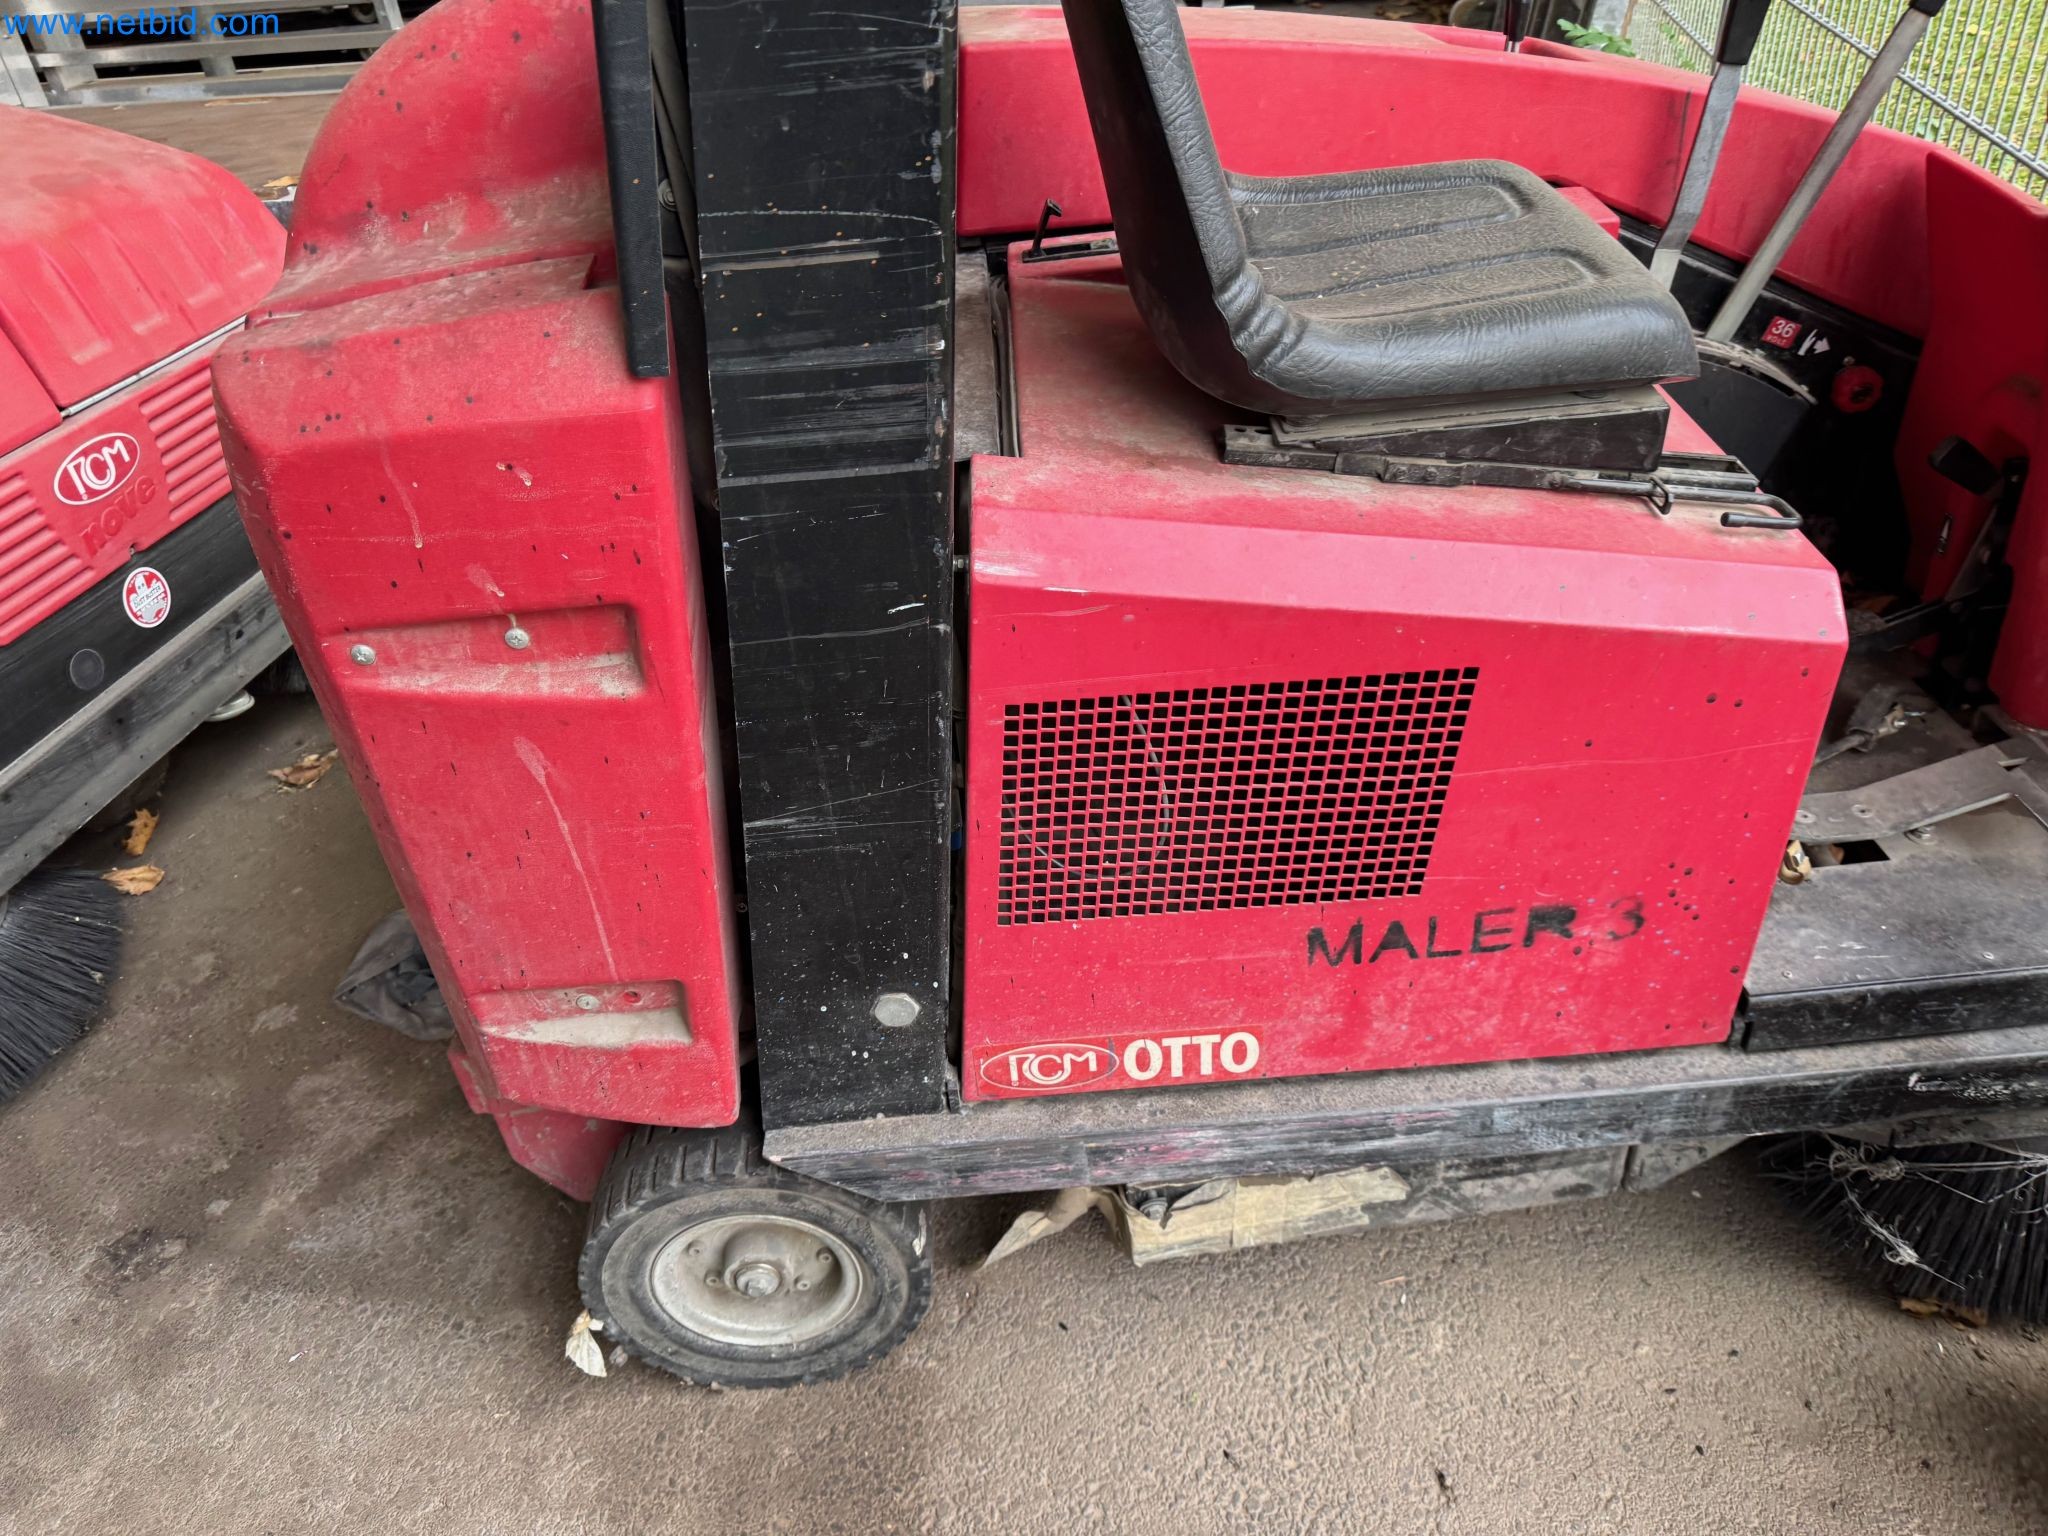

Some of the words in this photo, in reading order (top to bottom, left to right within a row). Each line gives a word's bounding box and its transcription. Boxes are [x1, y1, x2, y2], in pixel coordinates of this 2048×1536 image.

[1771, 319, 1796, 337] 36
[66, 439, 130, 500] RCM
[1305, 904, 1577, 968] MALER
[1609, 895, 1645, 941] 3
[1008, 1050, 1098, 1087] RCM
[1122, 1031, 1260, 1081] OTTO
